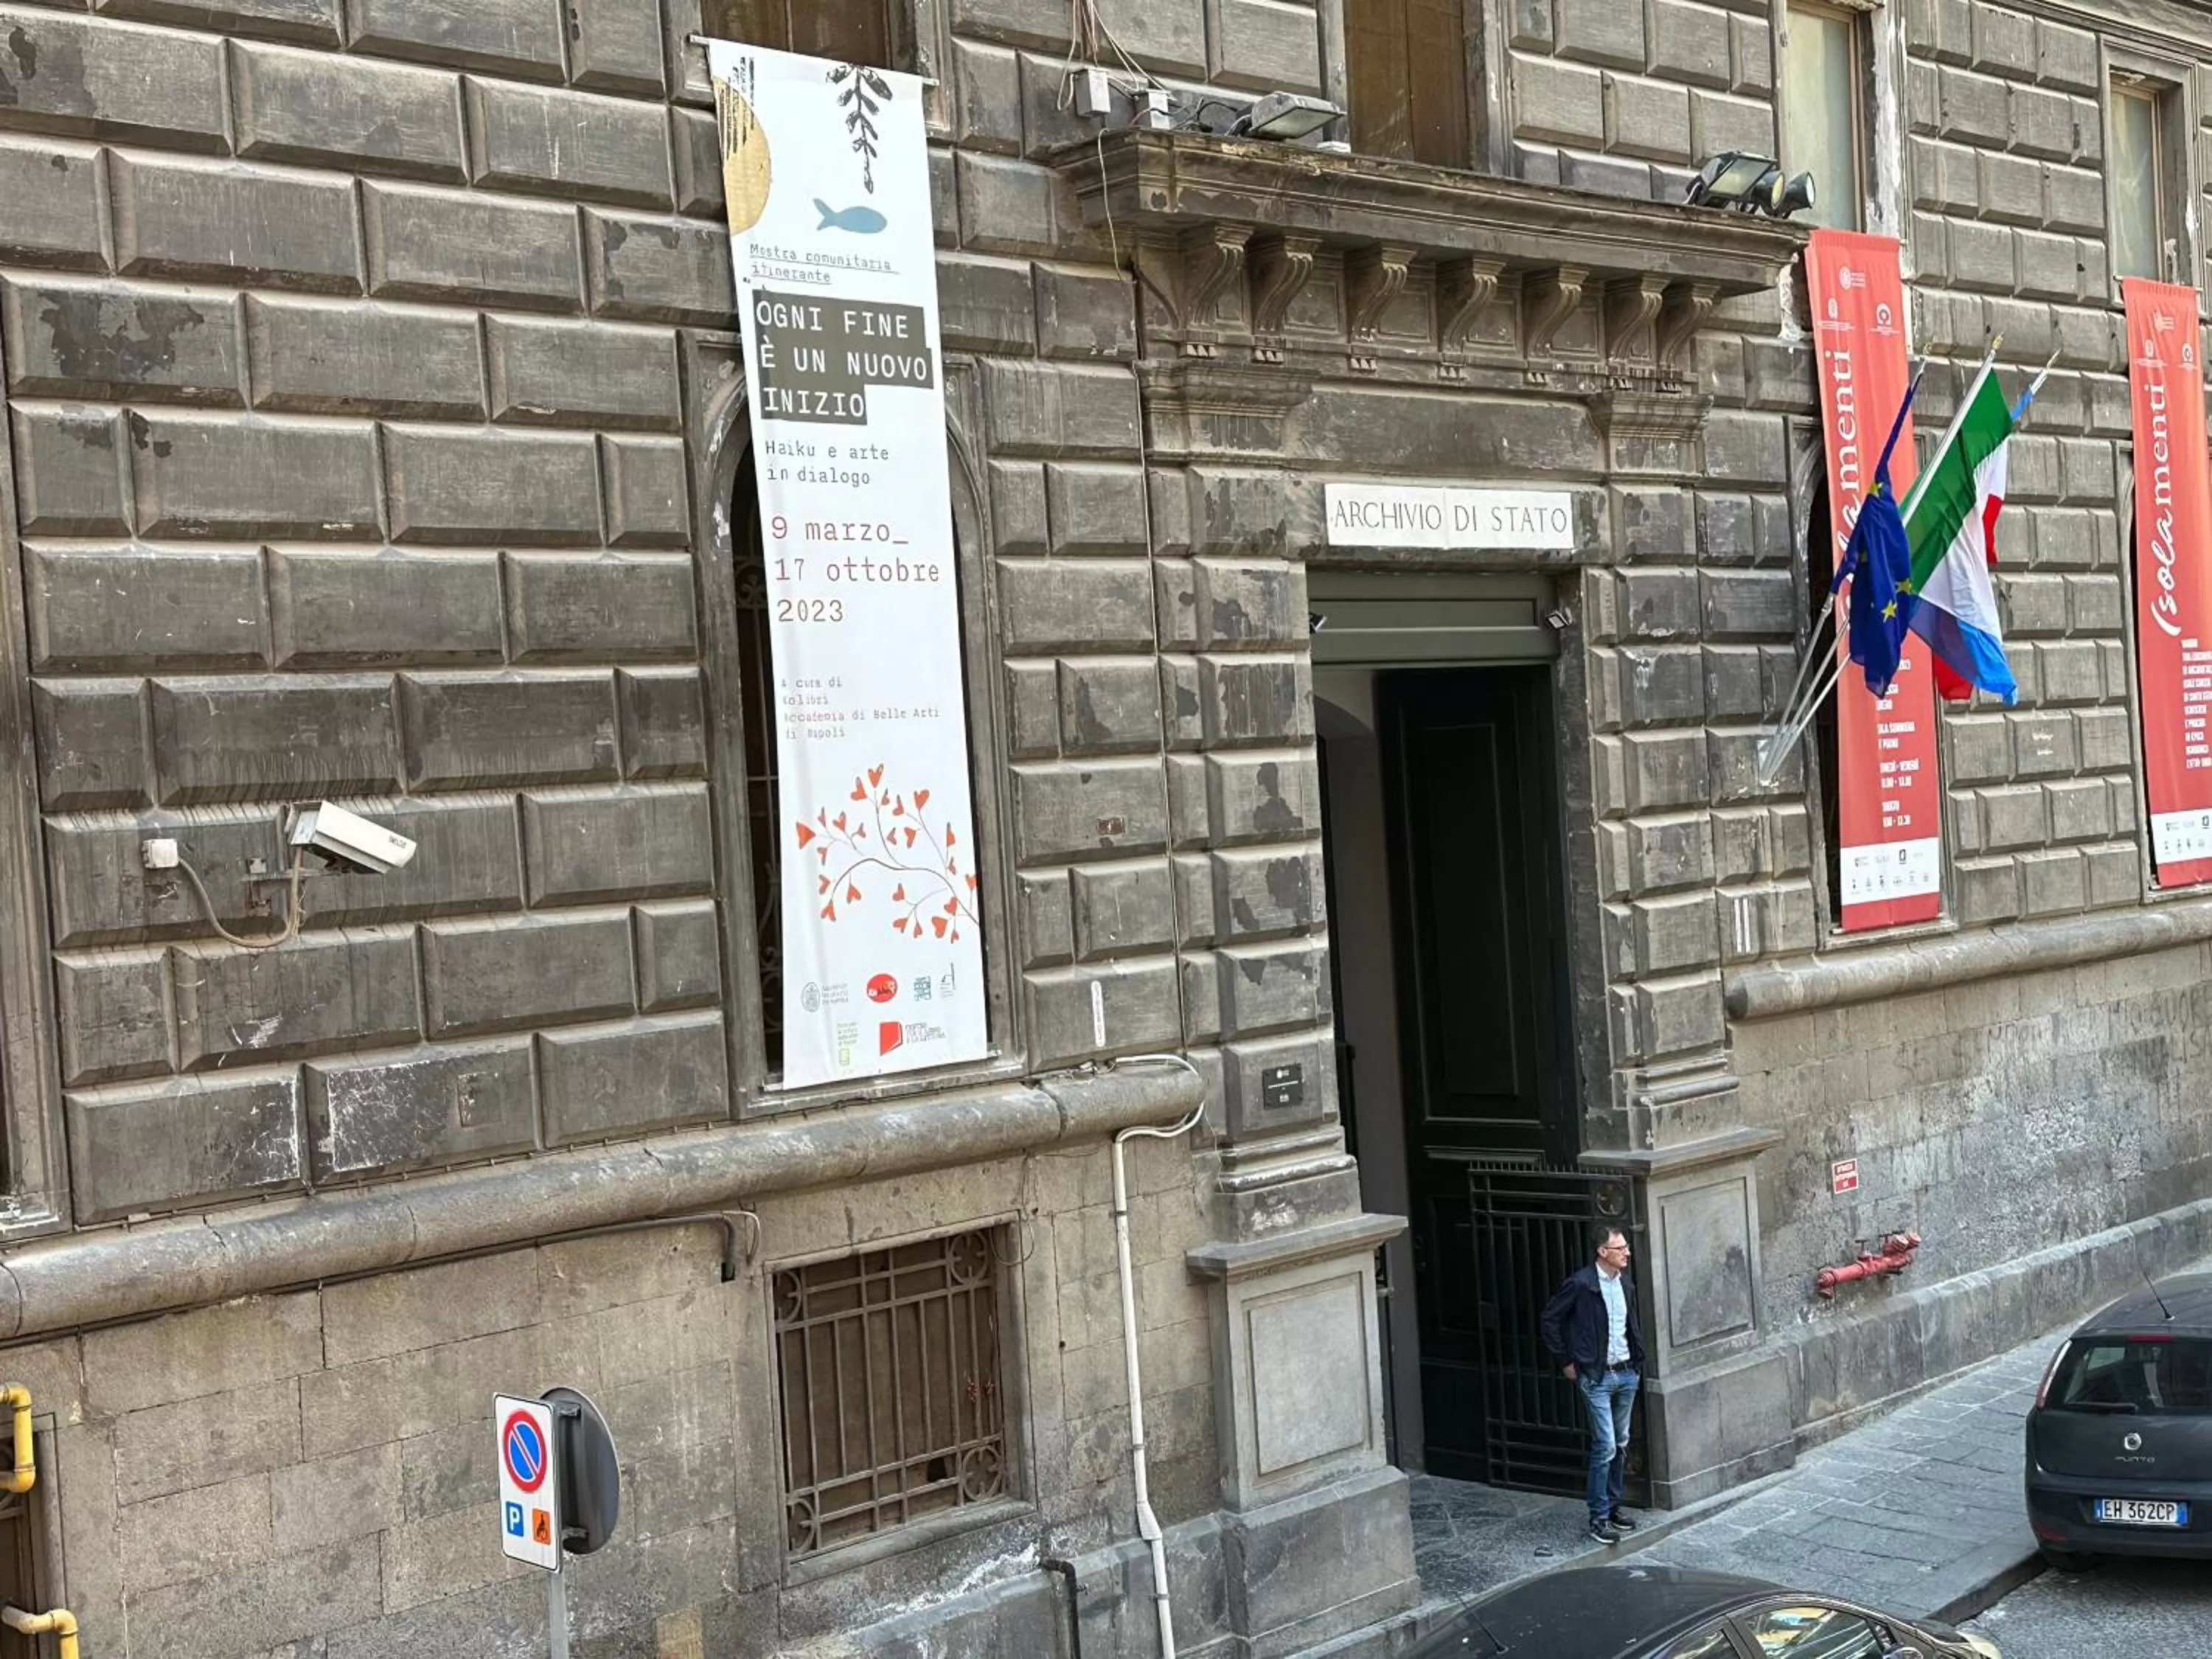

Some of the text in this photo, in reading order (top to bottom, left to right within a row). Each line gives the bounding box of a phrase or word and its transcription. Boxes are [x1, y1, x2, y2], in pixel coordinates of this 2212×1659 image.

[750, 243, 892, 271] Mostra comunitaria
[751, 262, 831, 282] itinerante
[756, 300, 909, 338] OGNI FINE
[759, 335, 927, 380] È UN NUOVO
[762, 386, 865, 417] INIZIO
[765, 440, 889, 460] Haiku e arte
[767, 464, 870, 488] in dialogo
[771, 515, 787, 540] 9
[1334, 500, 1568, 533] ARCHIVIO DI STATO
[774, 556, 939, 582] 17 ottobre
[776, 599, 844, 622] 2023
[509, 1506, 521, 1531] P
[2104, 1500, 2175, 1521] EH 362CP
